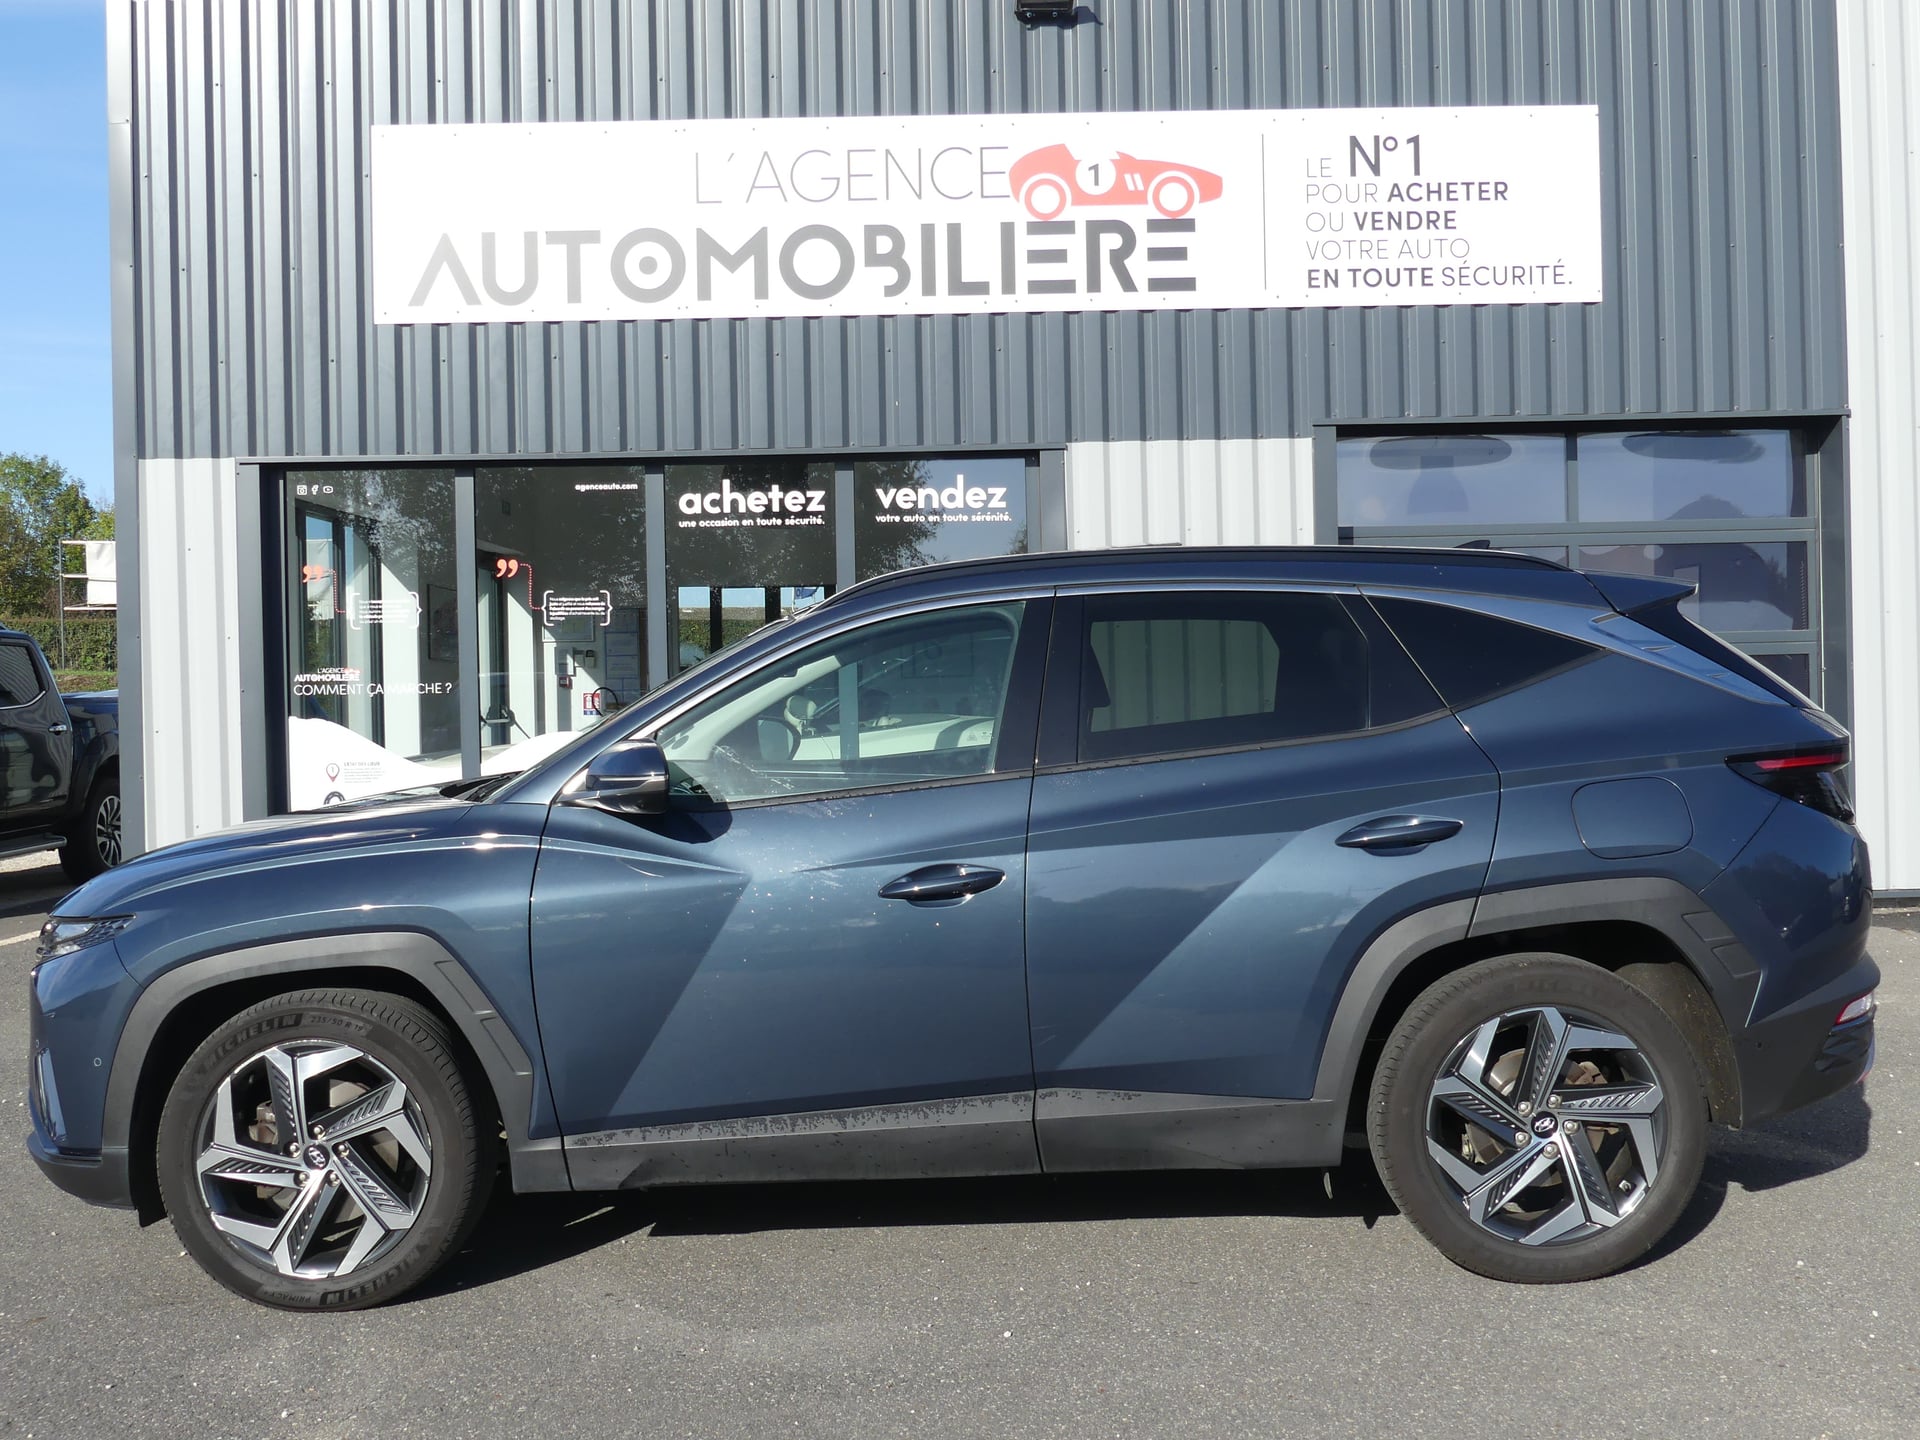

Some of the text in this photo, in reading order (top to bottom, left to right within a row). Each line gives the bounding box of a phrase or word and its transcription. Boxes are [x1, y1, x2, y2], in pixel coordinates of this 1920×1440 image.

[1088, 163, 1100, 187] 1
[1306, 158, 1333, 178] LE
[1306, 181, 1509, 204] POUR ACHETER
[1305, 210, 1457, 232] OU VENDRE
[1306, 238, 1470, 261] VOTRE AUTO
[1307, 259, 1573, 289] EN TOUTE SÉCURITÉ.
[575, 483, 638, 492] agenceauto.com
[678, 479, 826, 515] achetez
[875, 474, 1007, 509] vendez
[678, 520, 697, 528] une
[699, 517, 740, 527] occasion
[742, 519, 754, 527] en
[756, 517, 783, 526] toute
[875, 514, 901, 523] votre
[903, 514, 926, 523] auto
[943, 514, 969, 522] toute
[293, 684, 363, 696] COMMENT
[367, 683, 384, 697] ÇA
[444, 682, 452, 694] ?
[203, 1013, 298, 1070] MICHELIN
